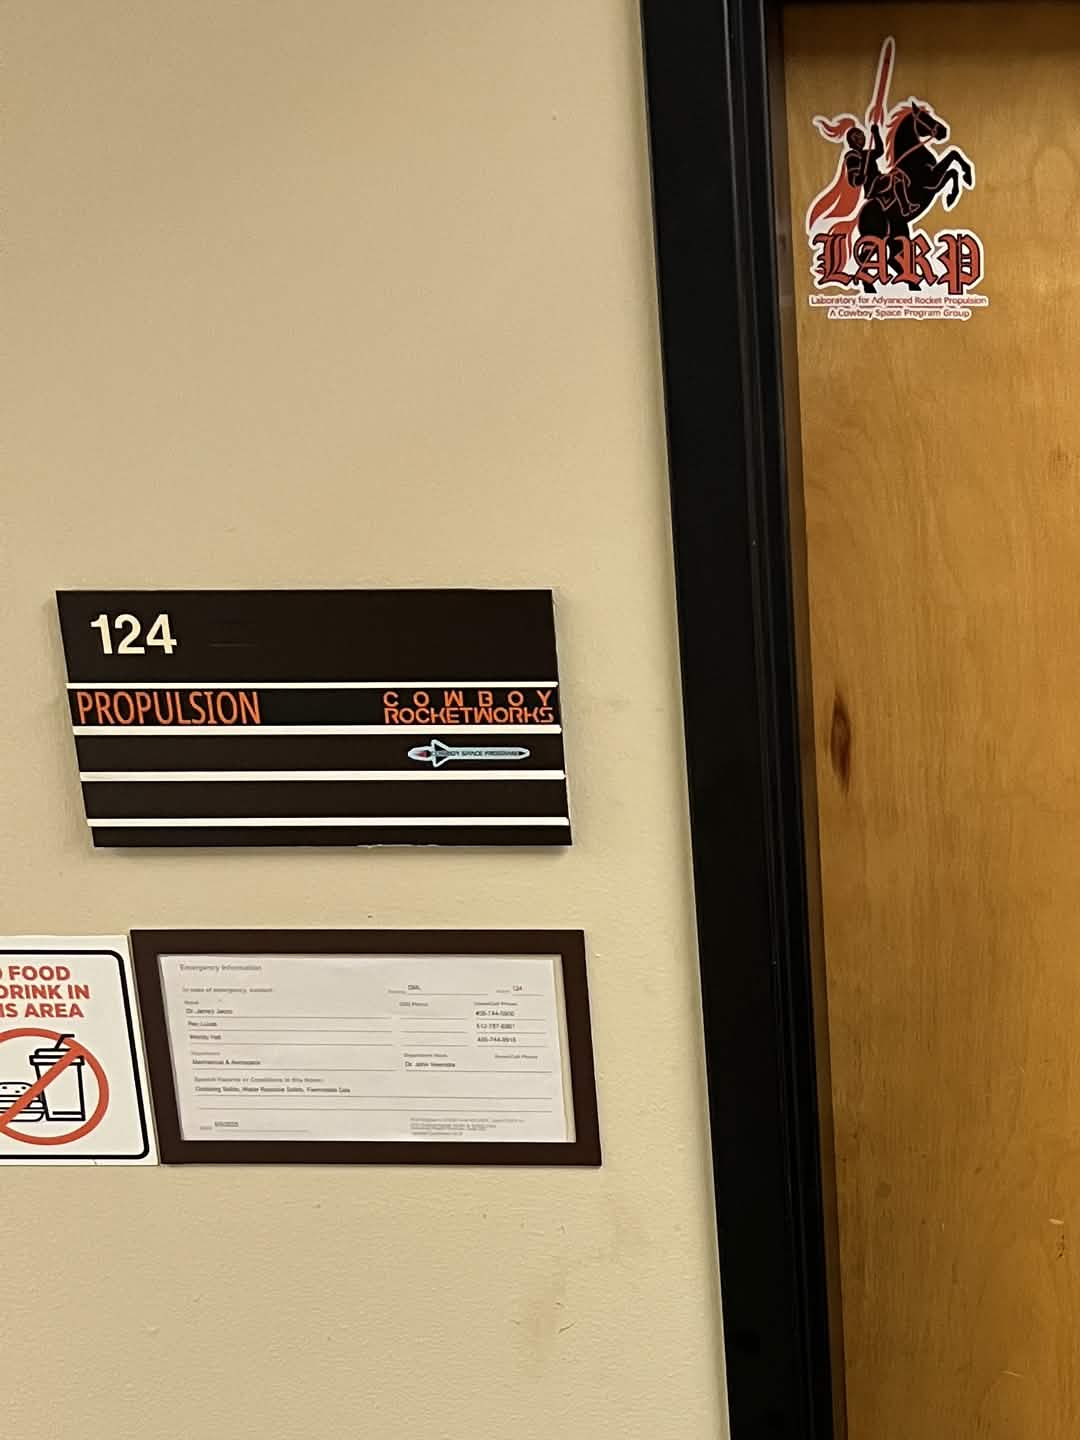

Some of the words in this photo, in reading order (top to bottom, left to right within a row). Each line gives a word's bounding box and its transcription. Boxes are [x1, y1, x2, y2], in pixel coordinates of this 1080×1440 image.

[813, 233, 982, 295] LARP
[811, 297, 856, 306] Laboratory
[858, 297, 870, 305] for
[873, 297, 913, 305] Advanced
[915, 297, 942, 305] Rocket
[944, 297, 987, 306] Propulsion
[838, 310, 872, 319] Cowboy
[875, 310, 901, 319] Space
[904, 310, 940, 319] Program
[943, 310, 970, 319] Group
[91, 614, 177, 654] 124
[383, 690, 553, 707] COWBOY
[76, 691, 261, 725] PROPULSION
[384, 707, 554, 724] ROCKETWORKS
[8, 966, 71, 981] FOOD
[68, 985, 90, 999] IN
[0, 1003, 18, 1018] IS
[24, 1003, 85, 1018] AREA
